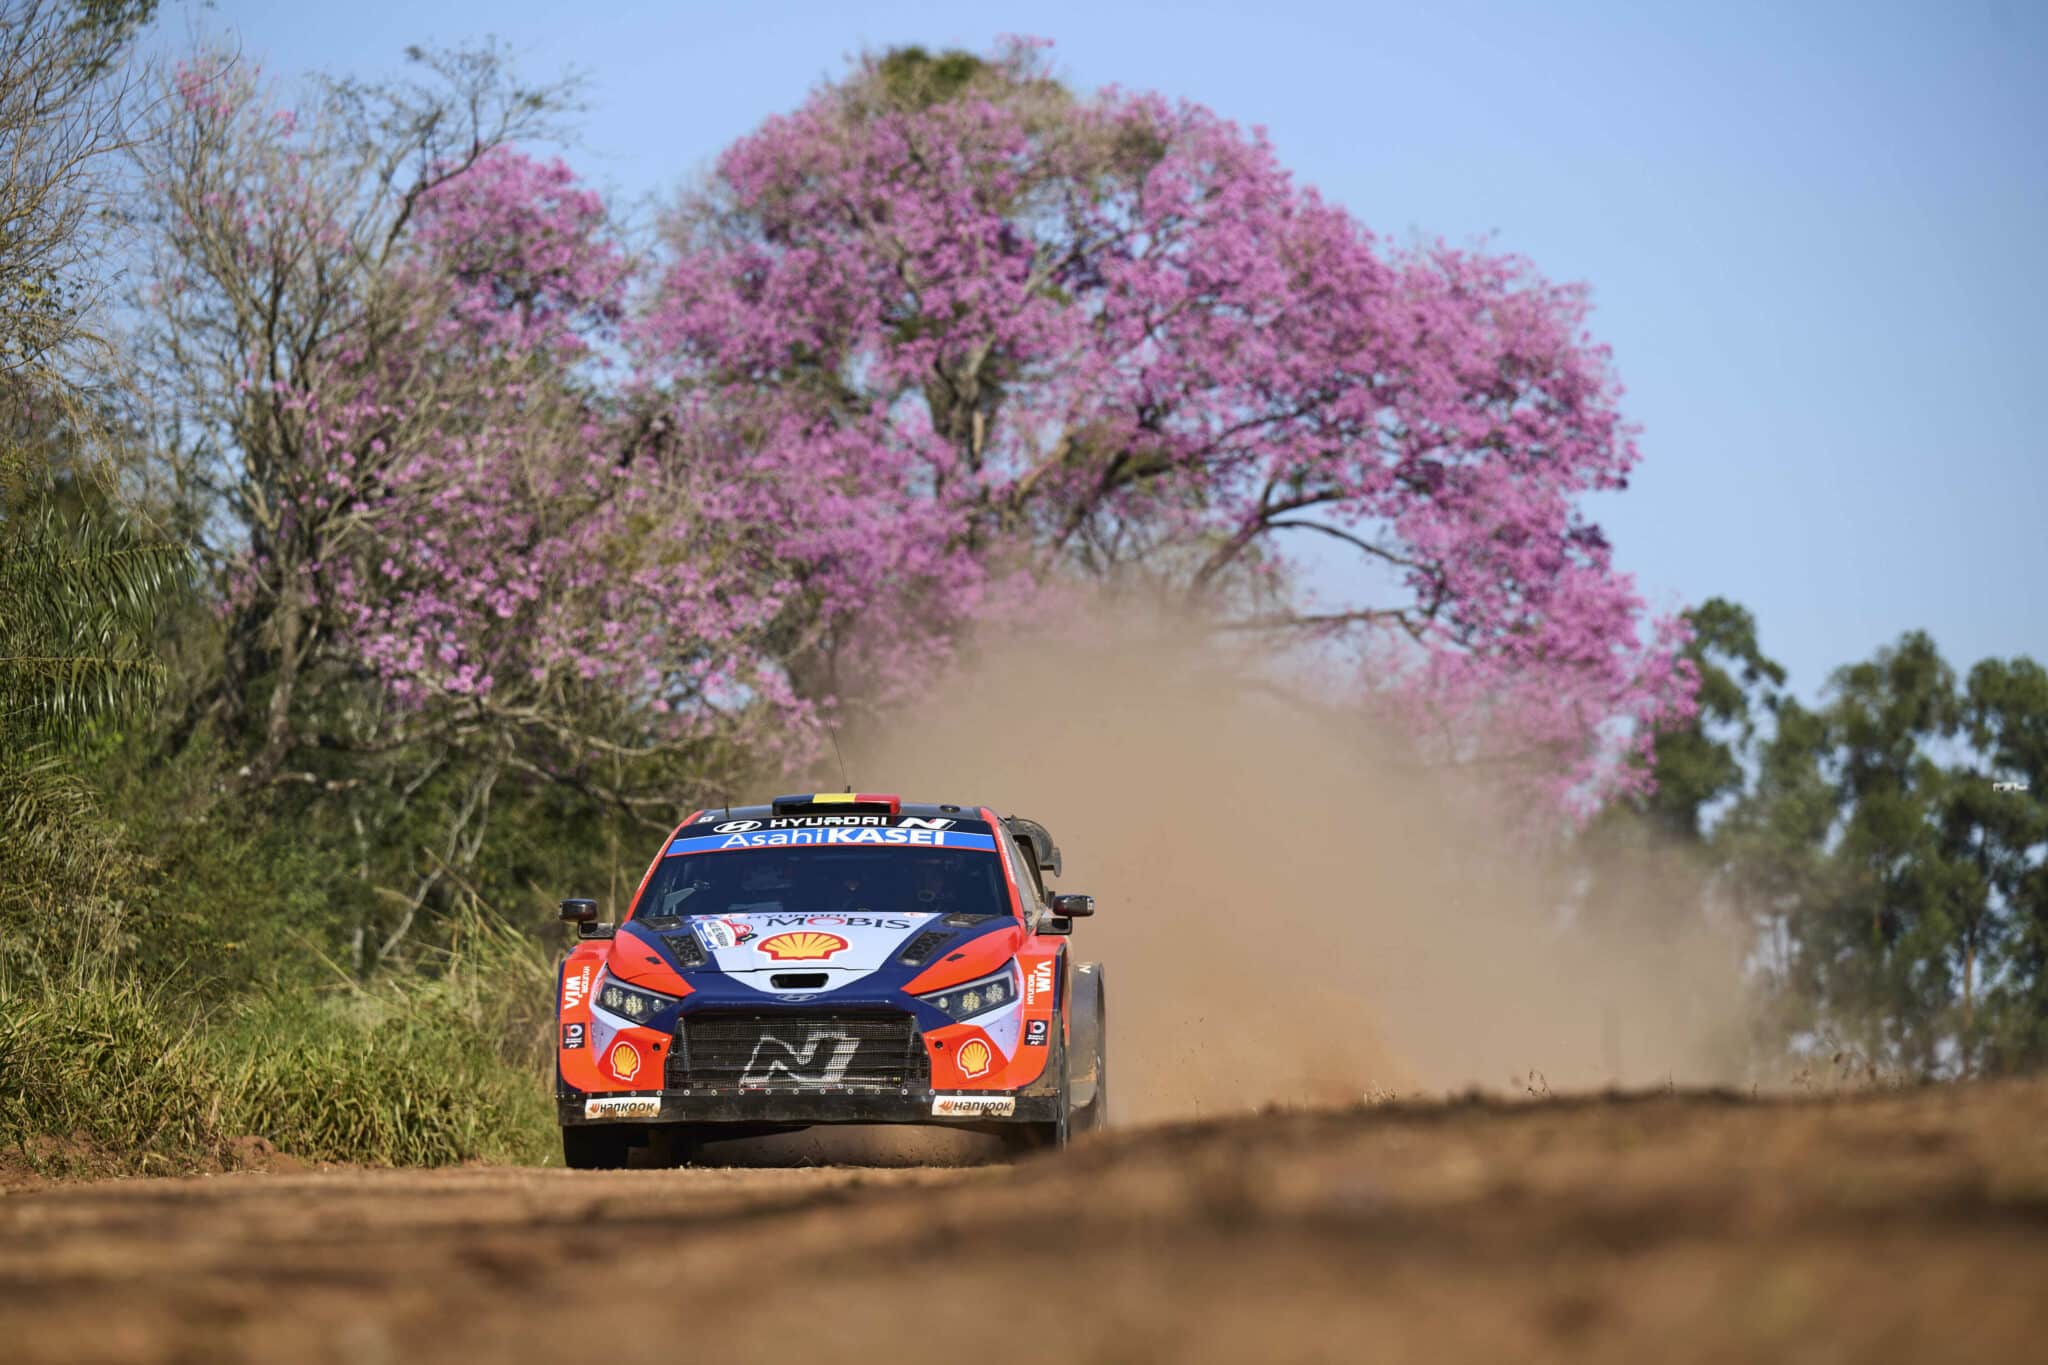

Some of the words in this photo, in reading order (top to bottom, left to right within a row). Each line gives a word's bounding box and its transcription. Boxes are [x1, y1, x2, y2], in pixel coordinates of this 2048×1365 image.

[770, 816, 887, 828] HYUNDAI
[897, 817, 957, 830] N
[766, 917, 911, 929] MOBIS
[1033, 960, 1052, 993] WIA
[563, 975, 584, 1009] WIA
